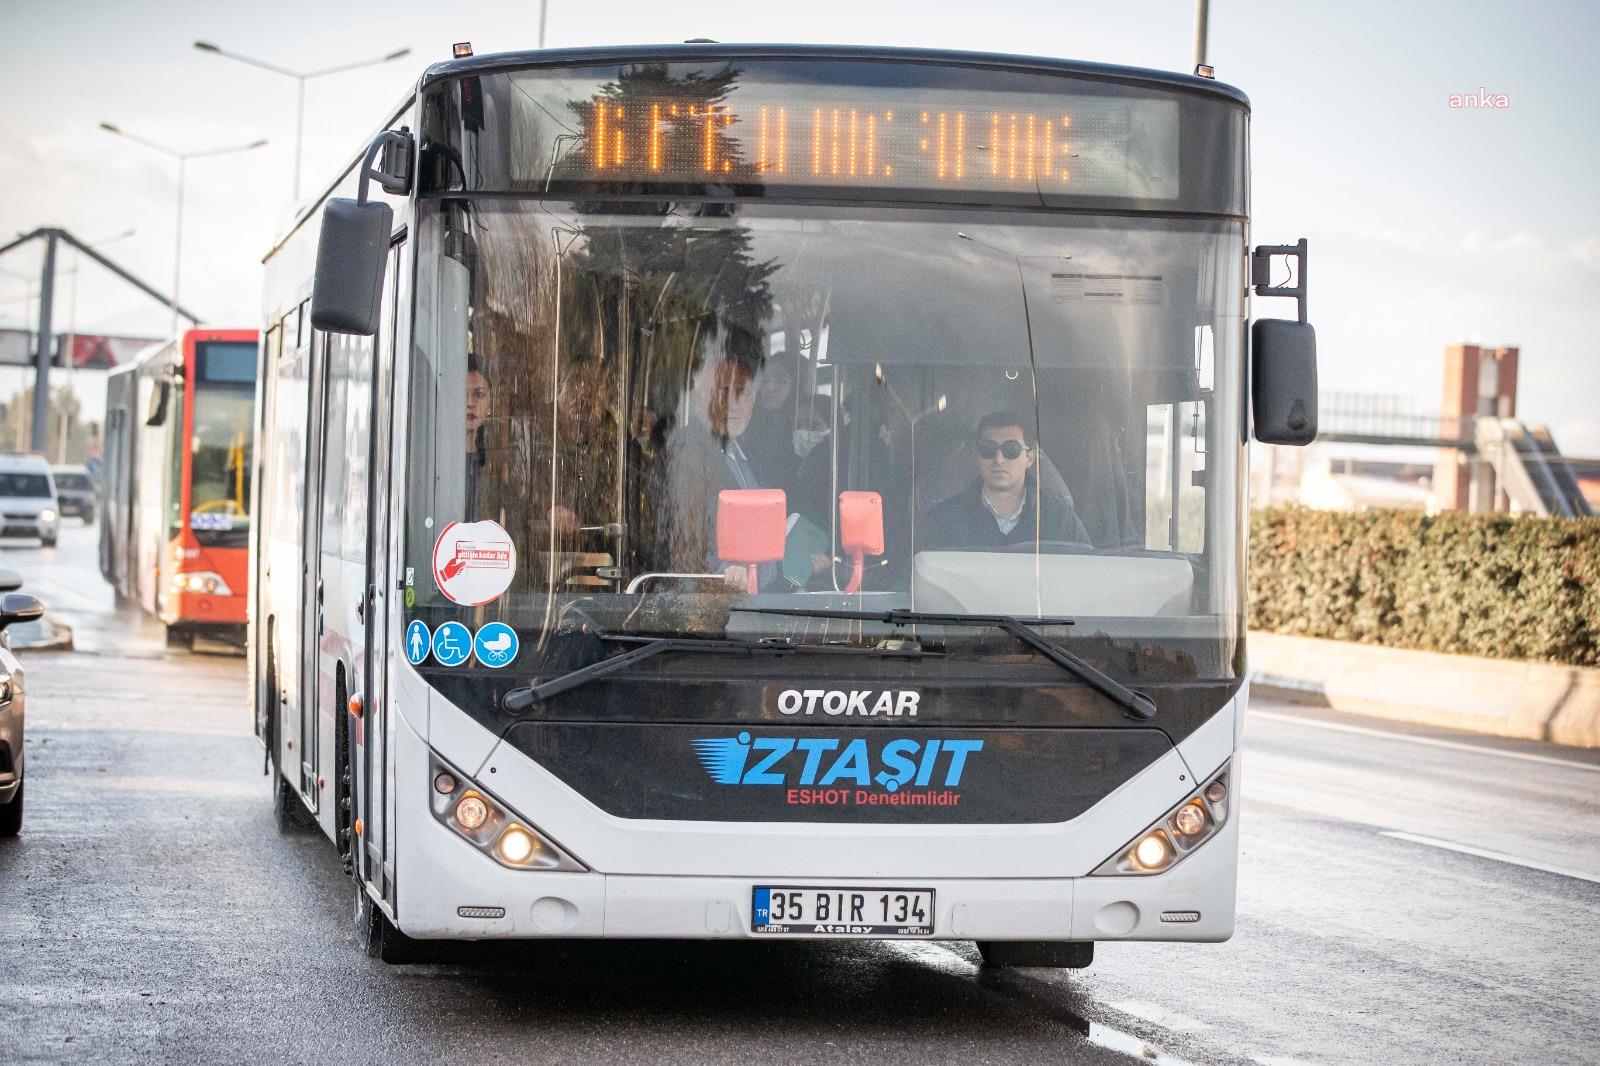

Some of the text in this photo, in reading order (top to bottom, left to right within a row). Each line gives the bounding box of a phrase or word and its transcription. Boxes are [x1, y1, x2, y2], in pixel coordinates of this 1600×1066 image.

[479, 551, 496, 559] kadar
[777, 689, 920, 716] OTOKAR
[787, 789, 960, 806] ESHOT Denetimlidir
[757, 893, 925, 923] TR 35 BIR 134
[814, 924, 873, 934] Atalay
